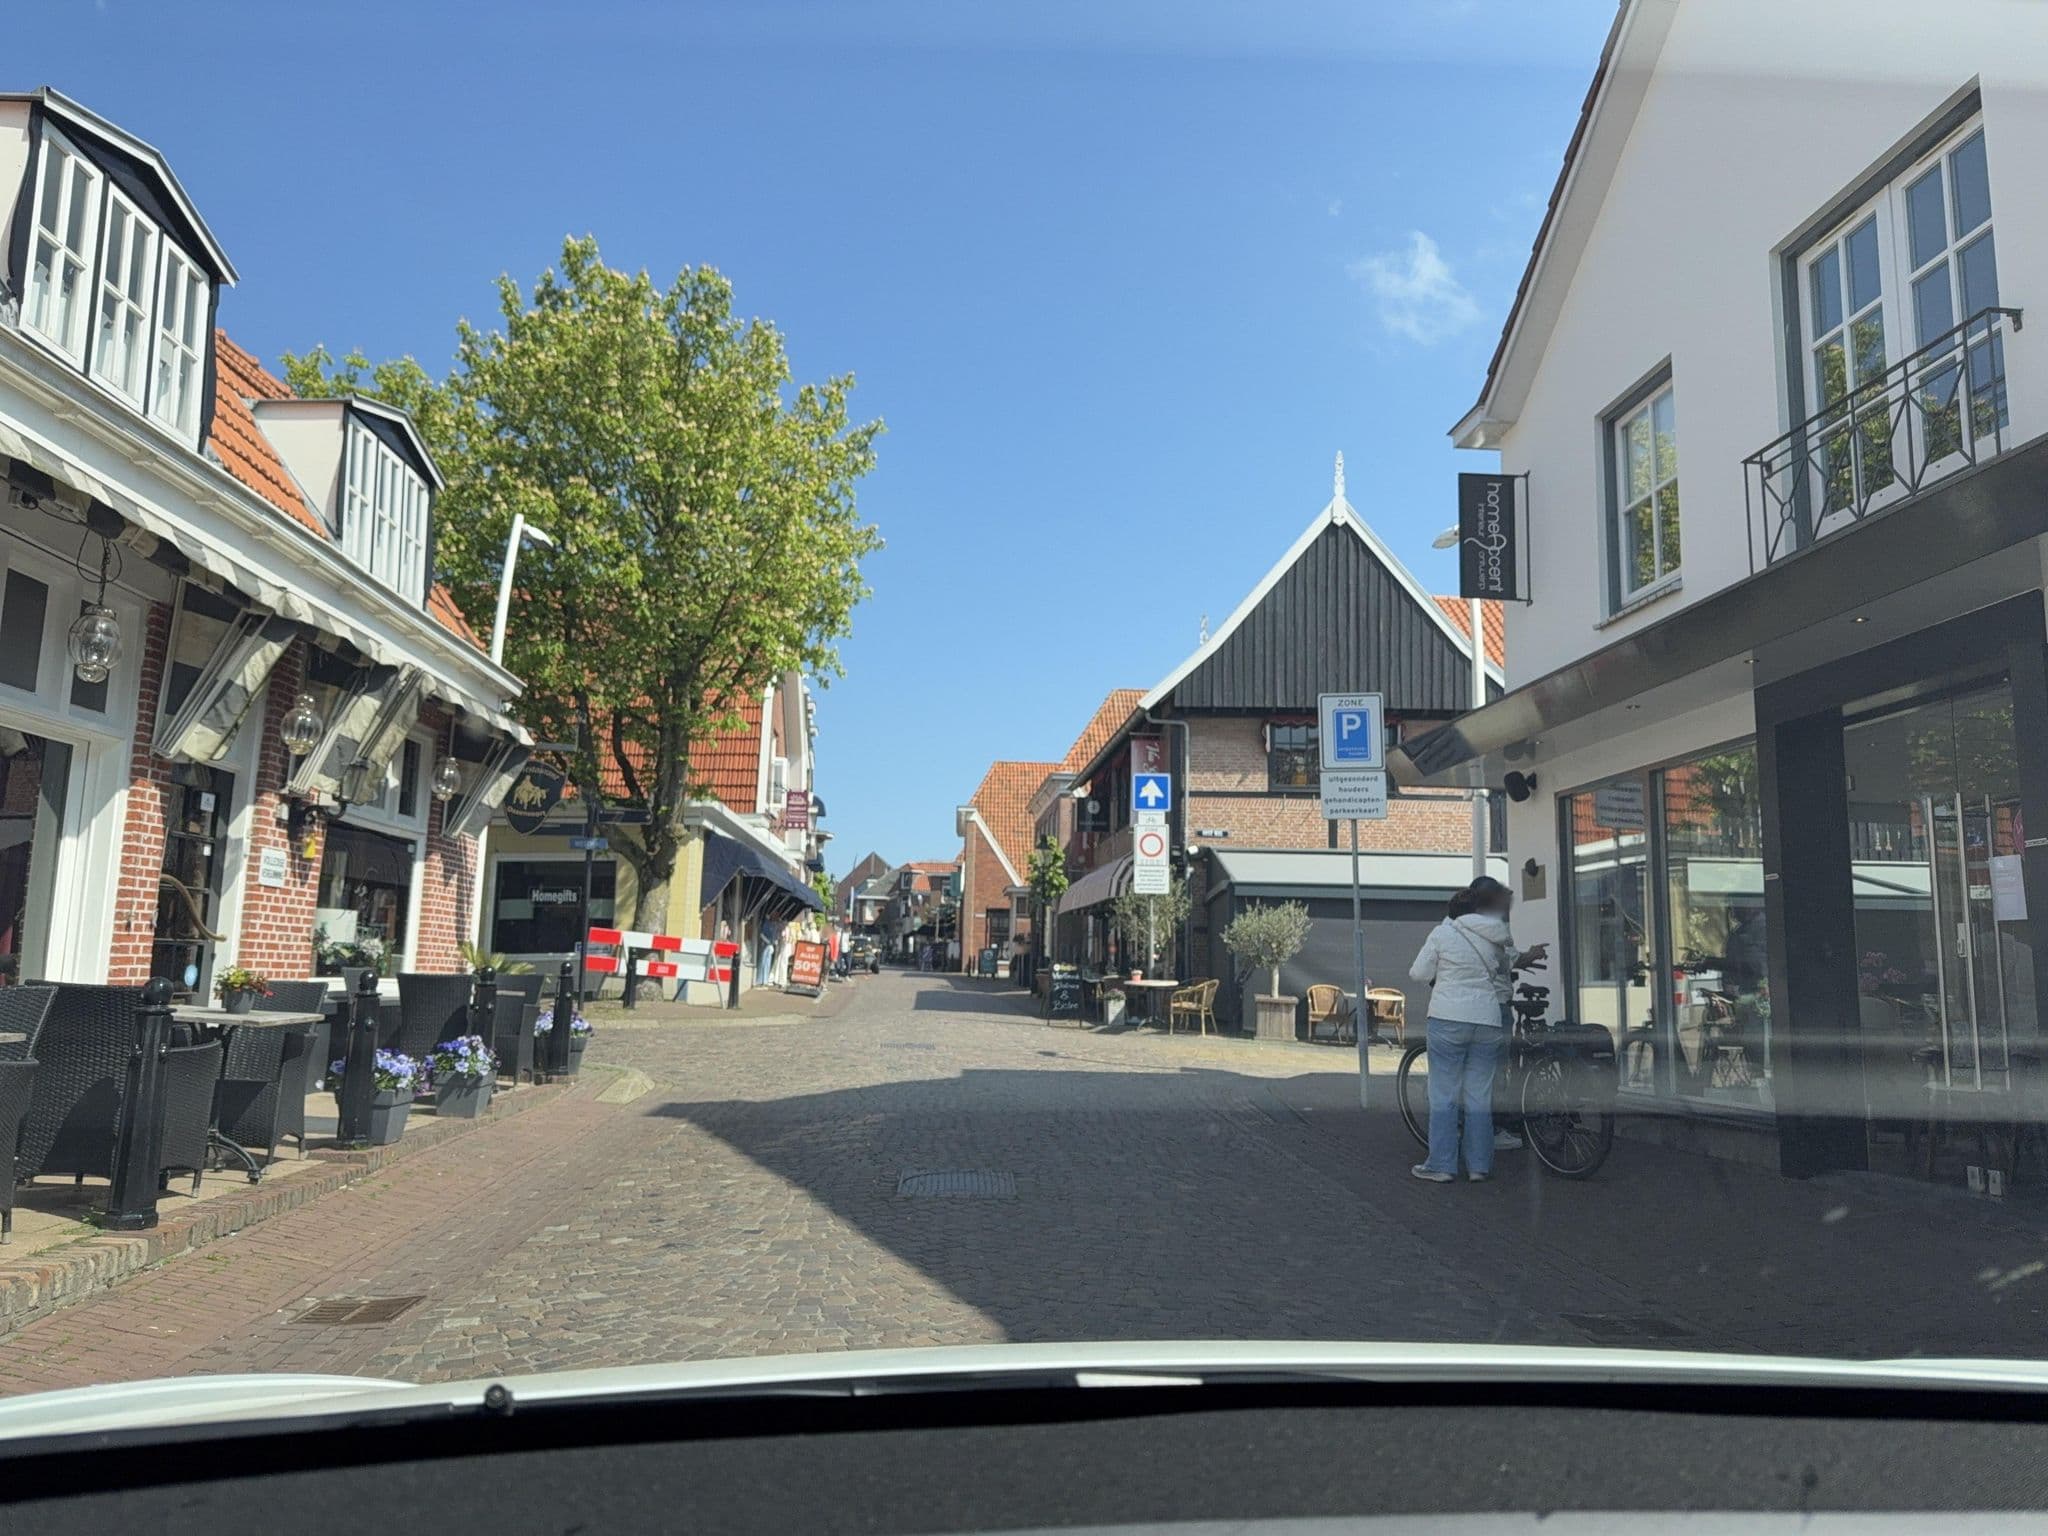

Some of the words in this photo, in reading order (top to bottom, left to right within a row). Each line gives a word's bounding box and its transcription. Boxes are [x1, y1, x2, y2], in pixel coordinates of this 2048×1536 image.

[1337, 699, 1364, 707] ZONE
[1341, 713, 1361, 740] P
[1328, 775, 1379, 784] uitgezonderd
[1329, 807, 1379, 815] parkeerkaart
[531, 889, 578, 904] Homegifts
[793, 960, 821, 974] 50%
